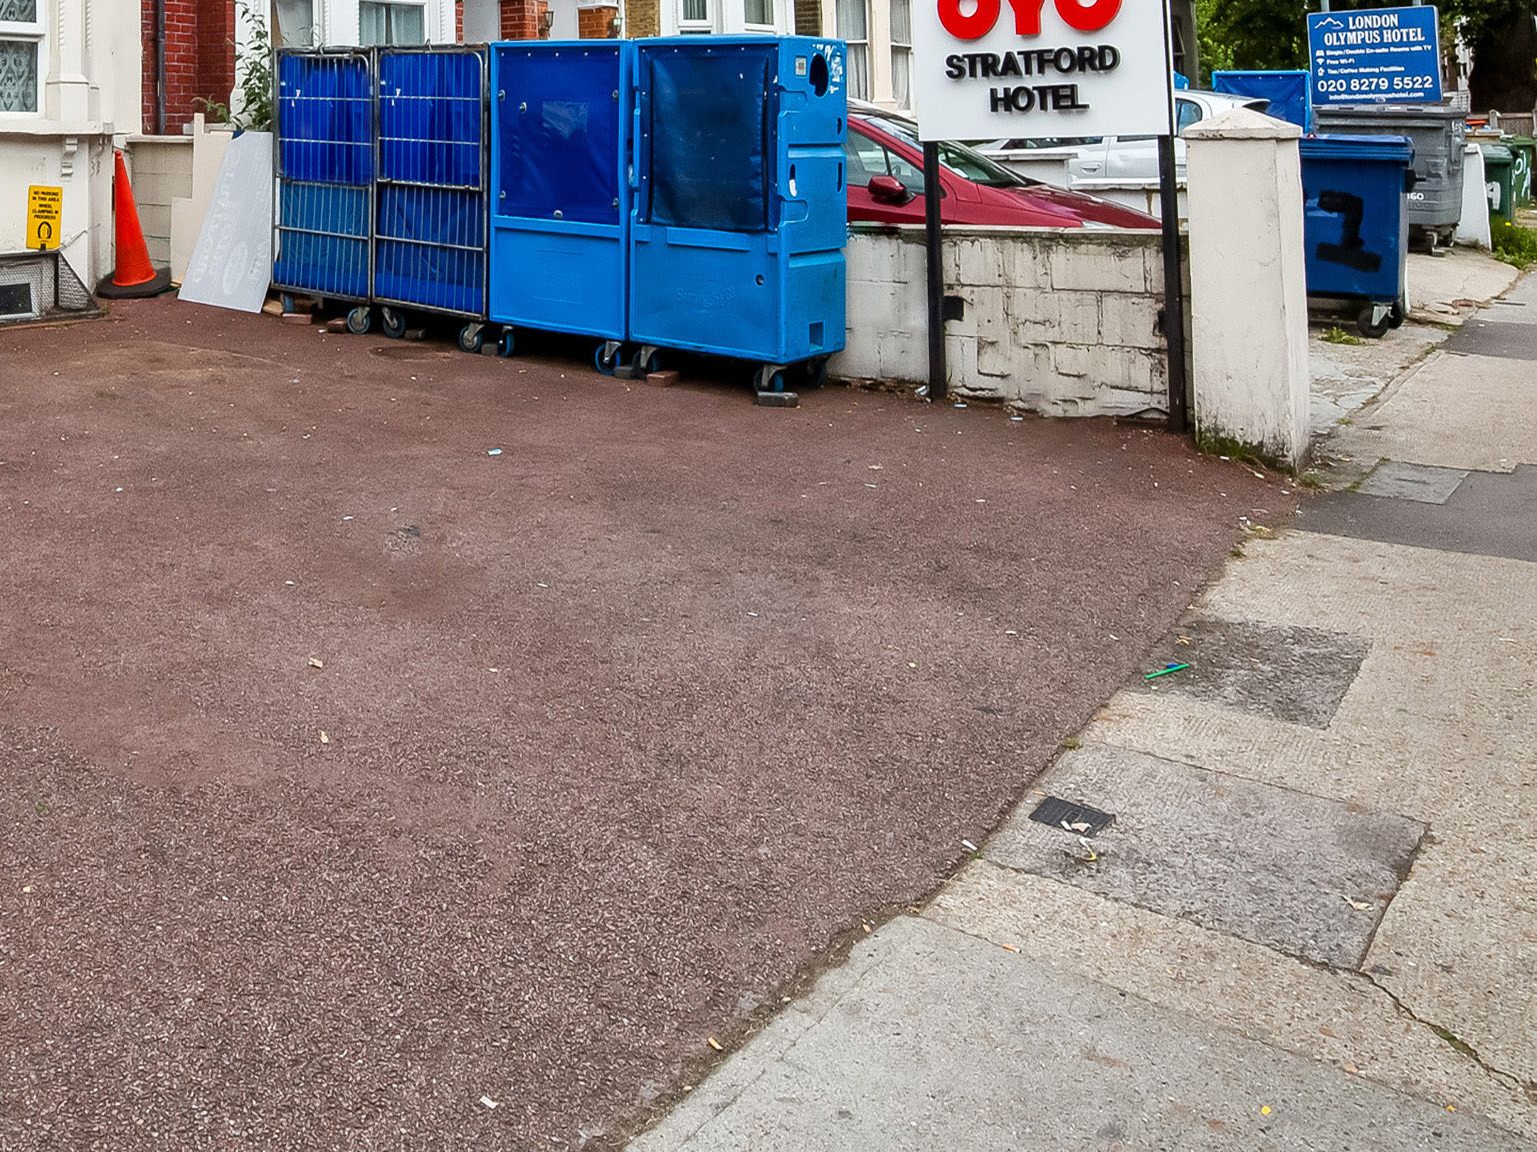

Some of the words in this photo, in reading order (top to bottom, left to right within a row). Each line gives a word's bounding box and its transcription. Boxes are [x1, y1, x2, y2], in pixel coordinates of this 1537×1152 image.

[1349, 14, 1398, 29] LONDON
[1324, 30, 1380, 46] OLYMPUS
[1383, 28, 1425, 42] HOTEL
[945, 45, 1121, 80] STRATFORD
[1318, 80, 1346, 92] 020
[1350, 78, 1388, 90] 8279
[1393, 76, 1433, 89] 5522
[990, 84, 1090, 113] HOTEL
